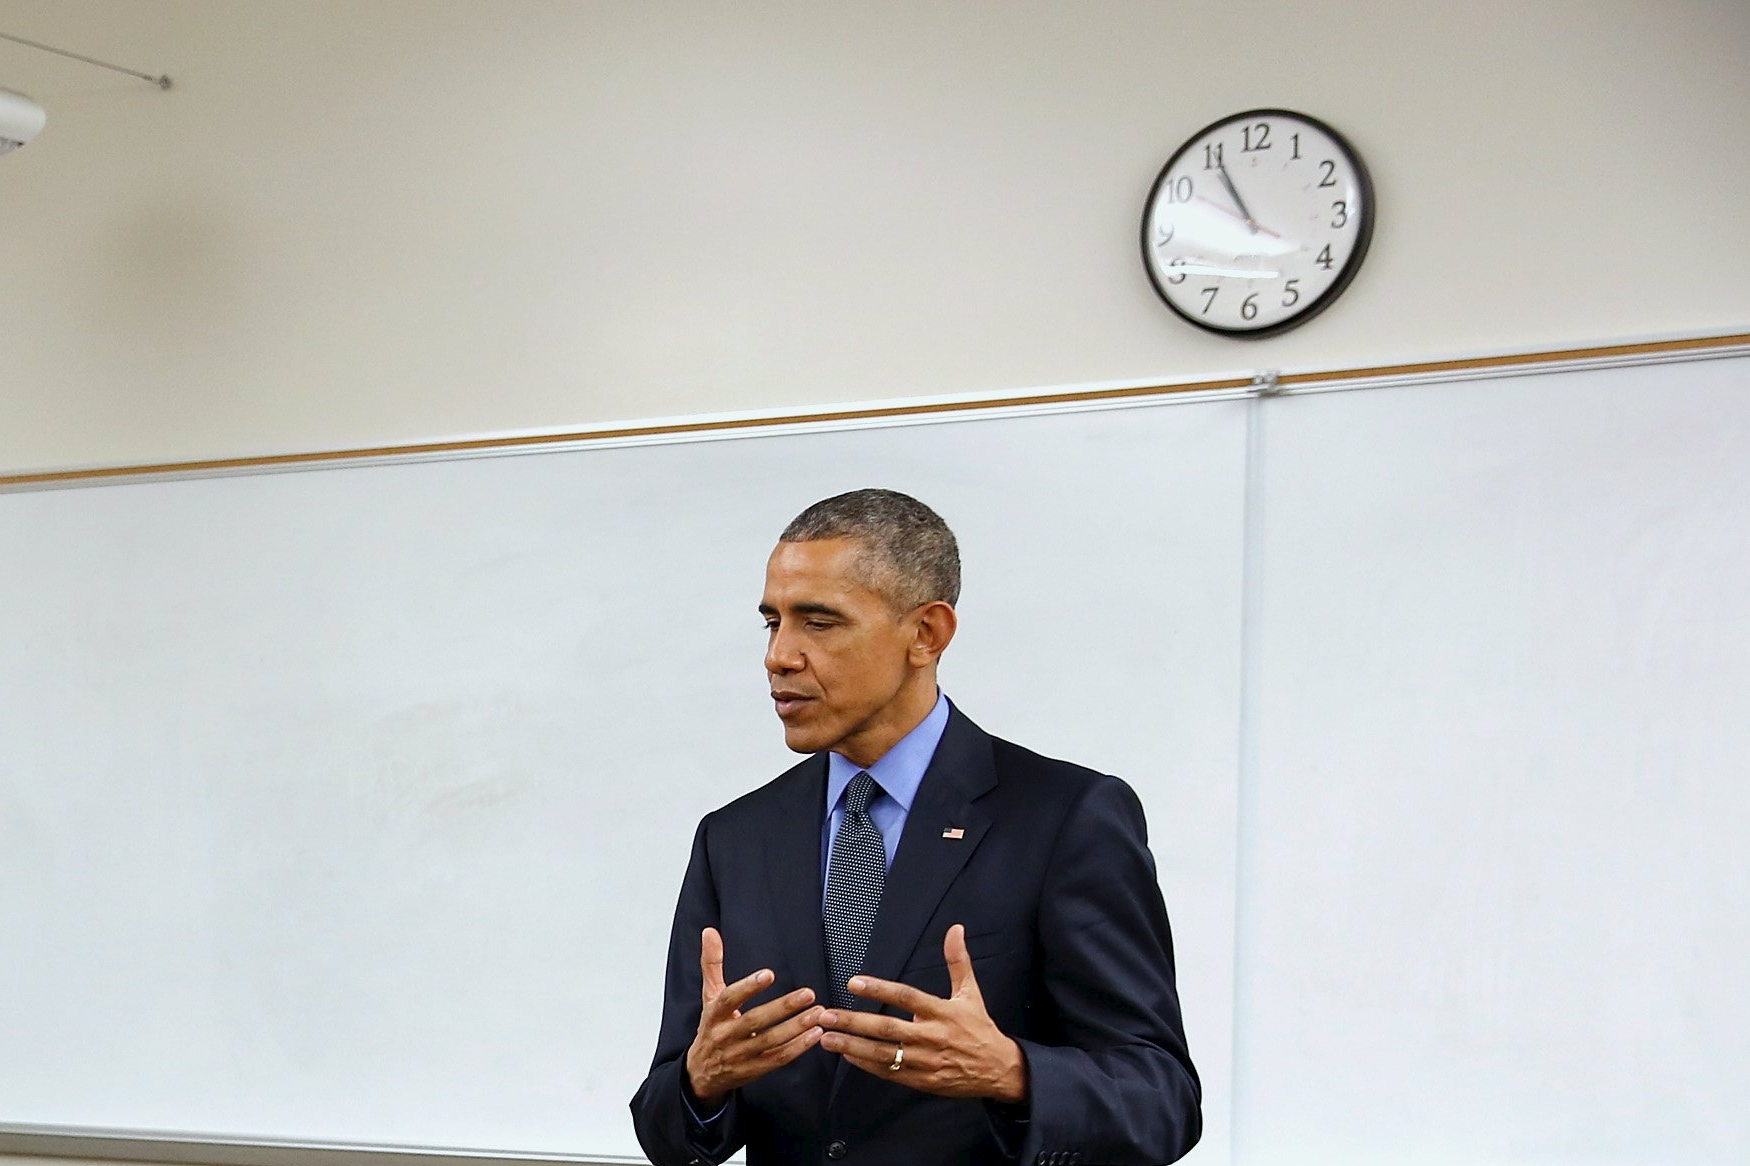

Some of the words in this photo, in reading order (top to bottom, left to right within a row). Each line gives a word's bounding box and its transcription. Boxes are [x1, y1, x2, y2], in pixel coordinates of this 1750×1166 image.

[1240, 122, 1272, 153] 12
[1290, 133, 1301, 160] 1
[1203, 142, 1225, 170] 11
[1318, 159, 1336, 188] 2
[1167, 175, 1193, 204] 10
[1330, 200, 1348, 228] 3
[1157, 223, 1174, 247] 9
[1316, 243, 1333, 270] 4
[1202, 287, 1219, 315] 7
[1241, 293, 1258, 321] 6
[1282, 279, 1299, 307] 5
